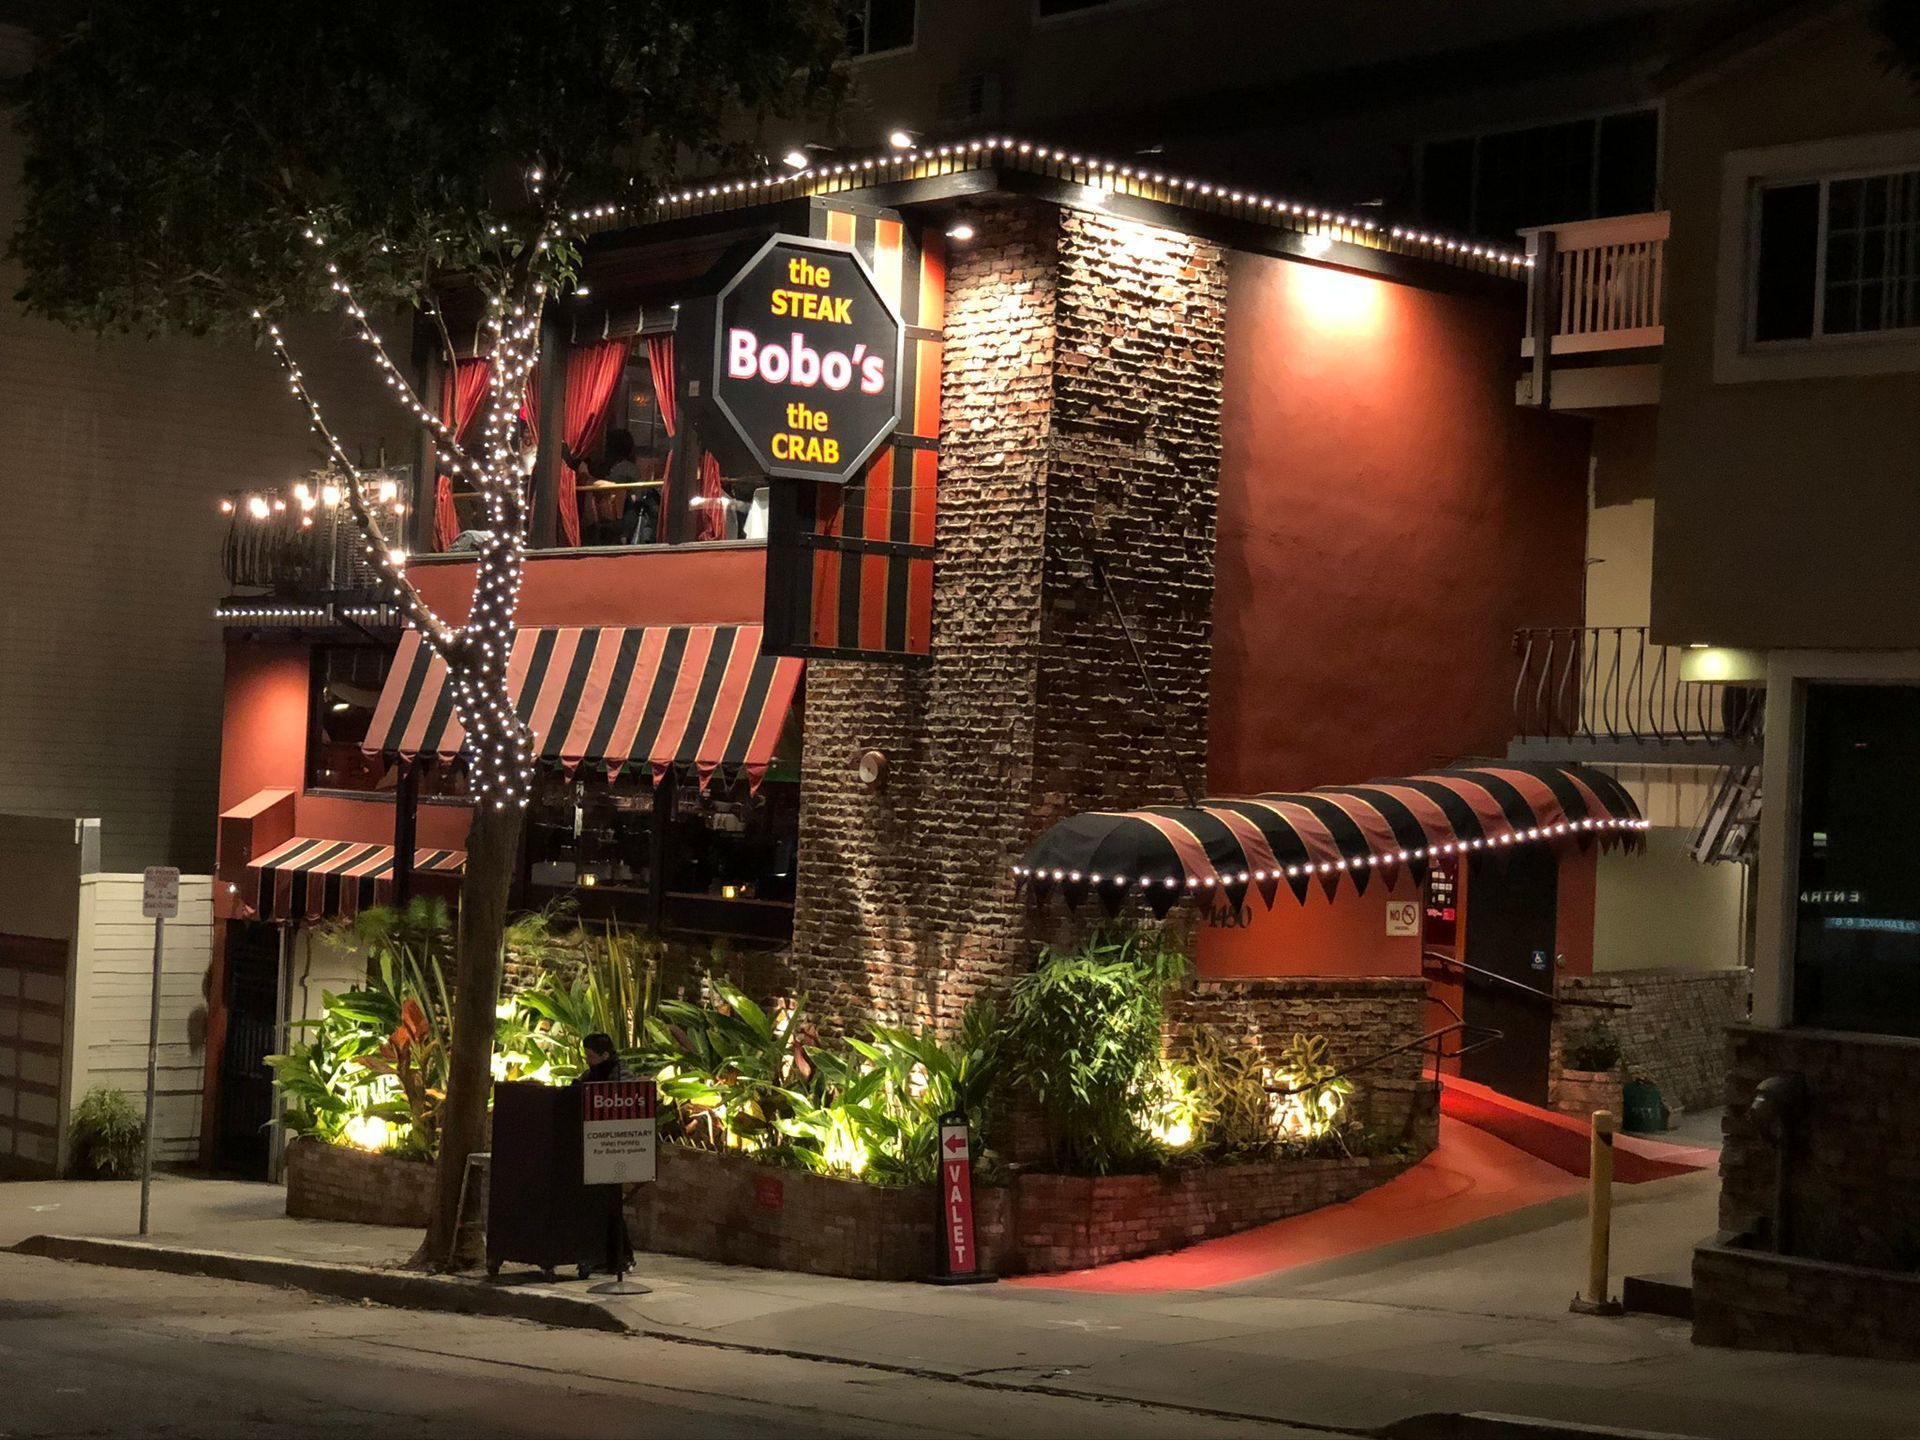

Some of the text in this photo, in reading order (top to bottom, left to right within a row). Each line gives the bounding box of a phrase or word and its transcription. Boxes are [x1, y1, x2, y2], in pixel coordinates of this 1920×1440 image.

[788, 258, 830, 288] the
[771, 289, 853, 325] STEAK
[728, 327, 885, 395] Bobo's
[786, 403, 828, 432] the
[771, 433, 840, 464] CRAB
[1389, 909, 1401, 921] NO
[593, 1093, 646, 1109] Bobo's
[587, 1130, 652, 1139] COMPLIMENTARY
[949, 1165, 965, 1264] VALET
